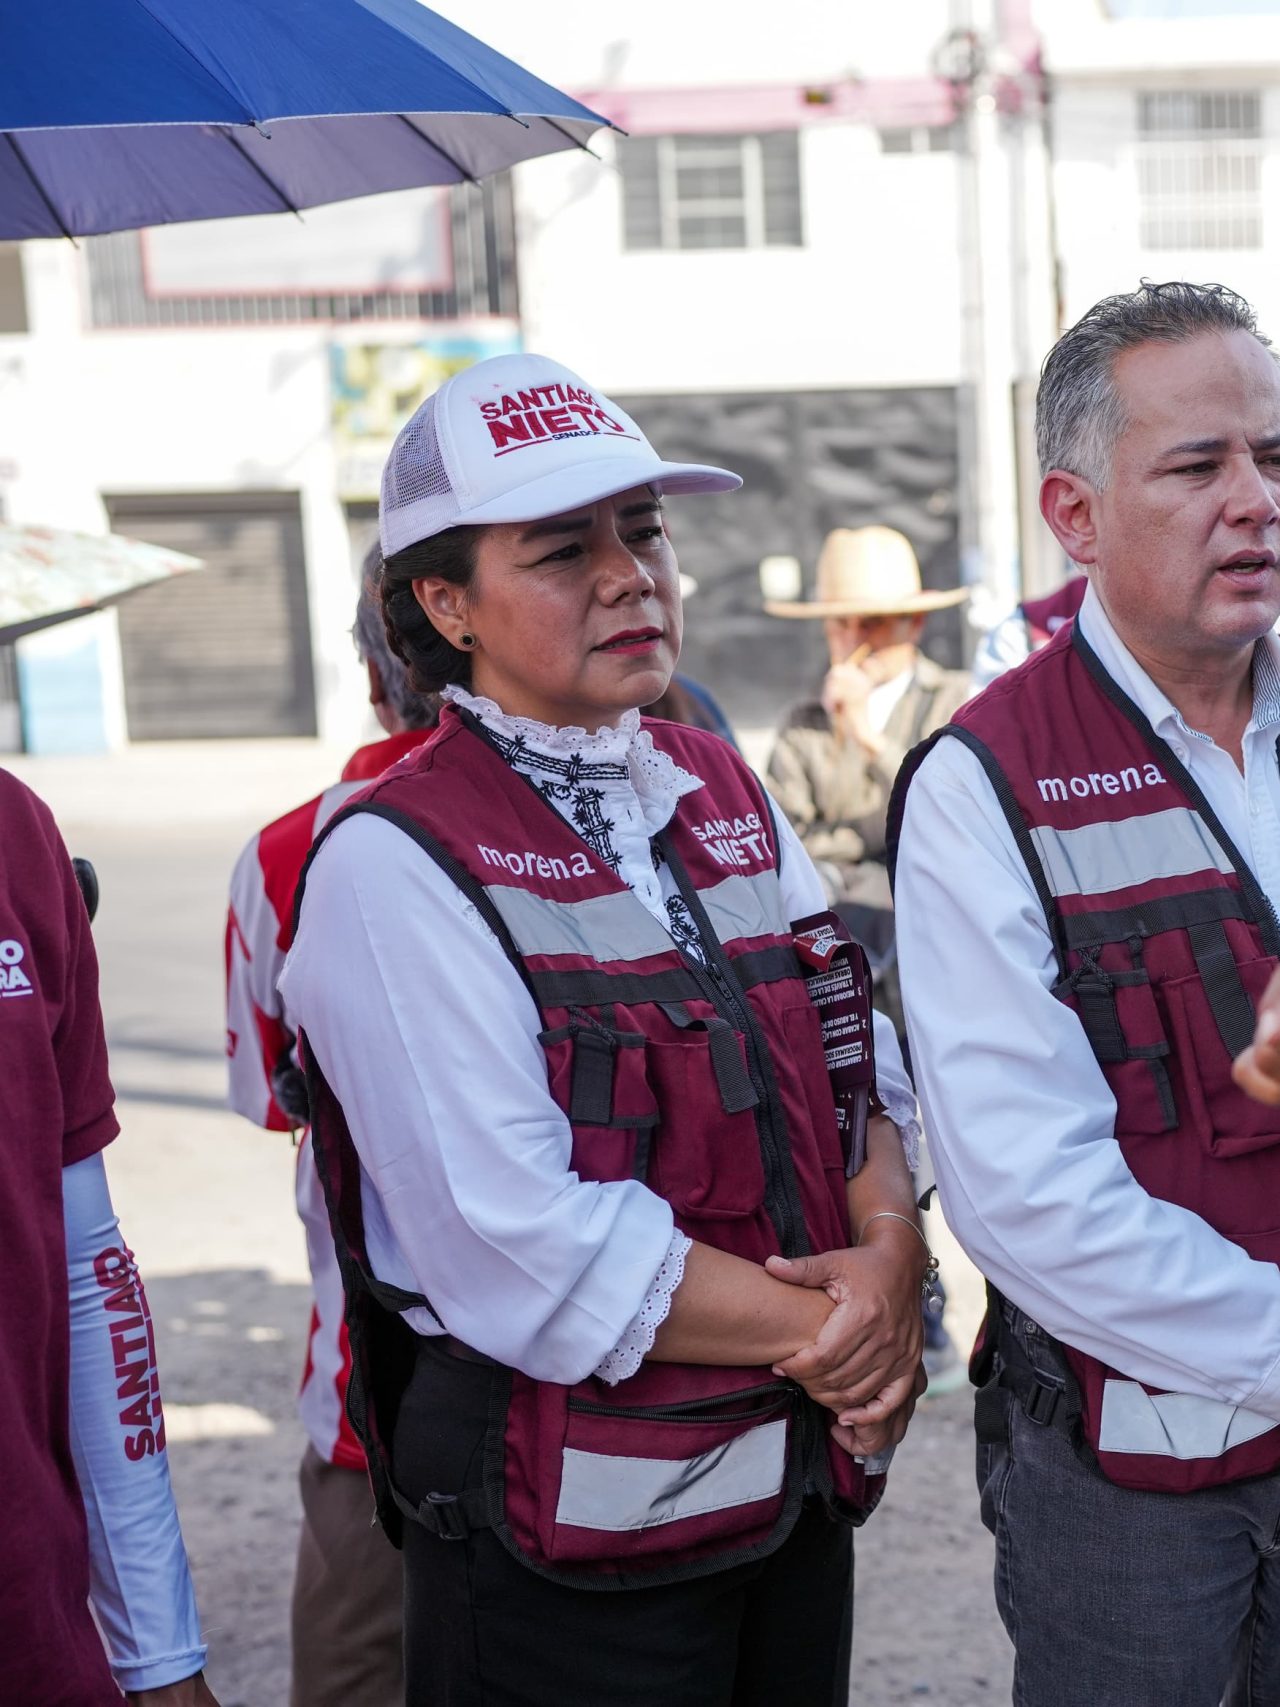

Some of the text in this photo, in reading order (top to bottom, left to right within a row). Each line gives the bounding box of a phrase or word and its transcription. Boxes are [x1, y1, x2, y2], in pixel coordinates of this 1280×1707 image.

[487, 403, 625, 448] NIETO
[1037, 763, 1167, 802] morena
[477, 844, 596, 880] morena
[857, 986, 862, 996] 3
[862, 1019, 867, 1029] 2
